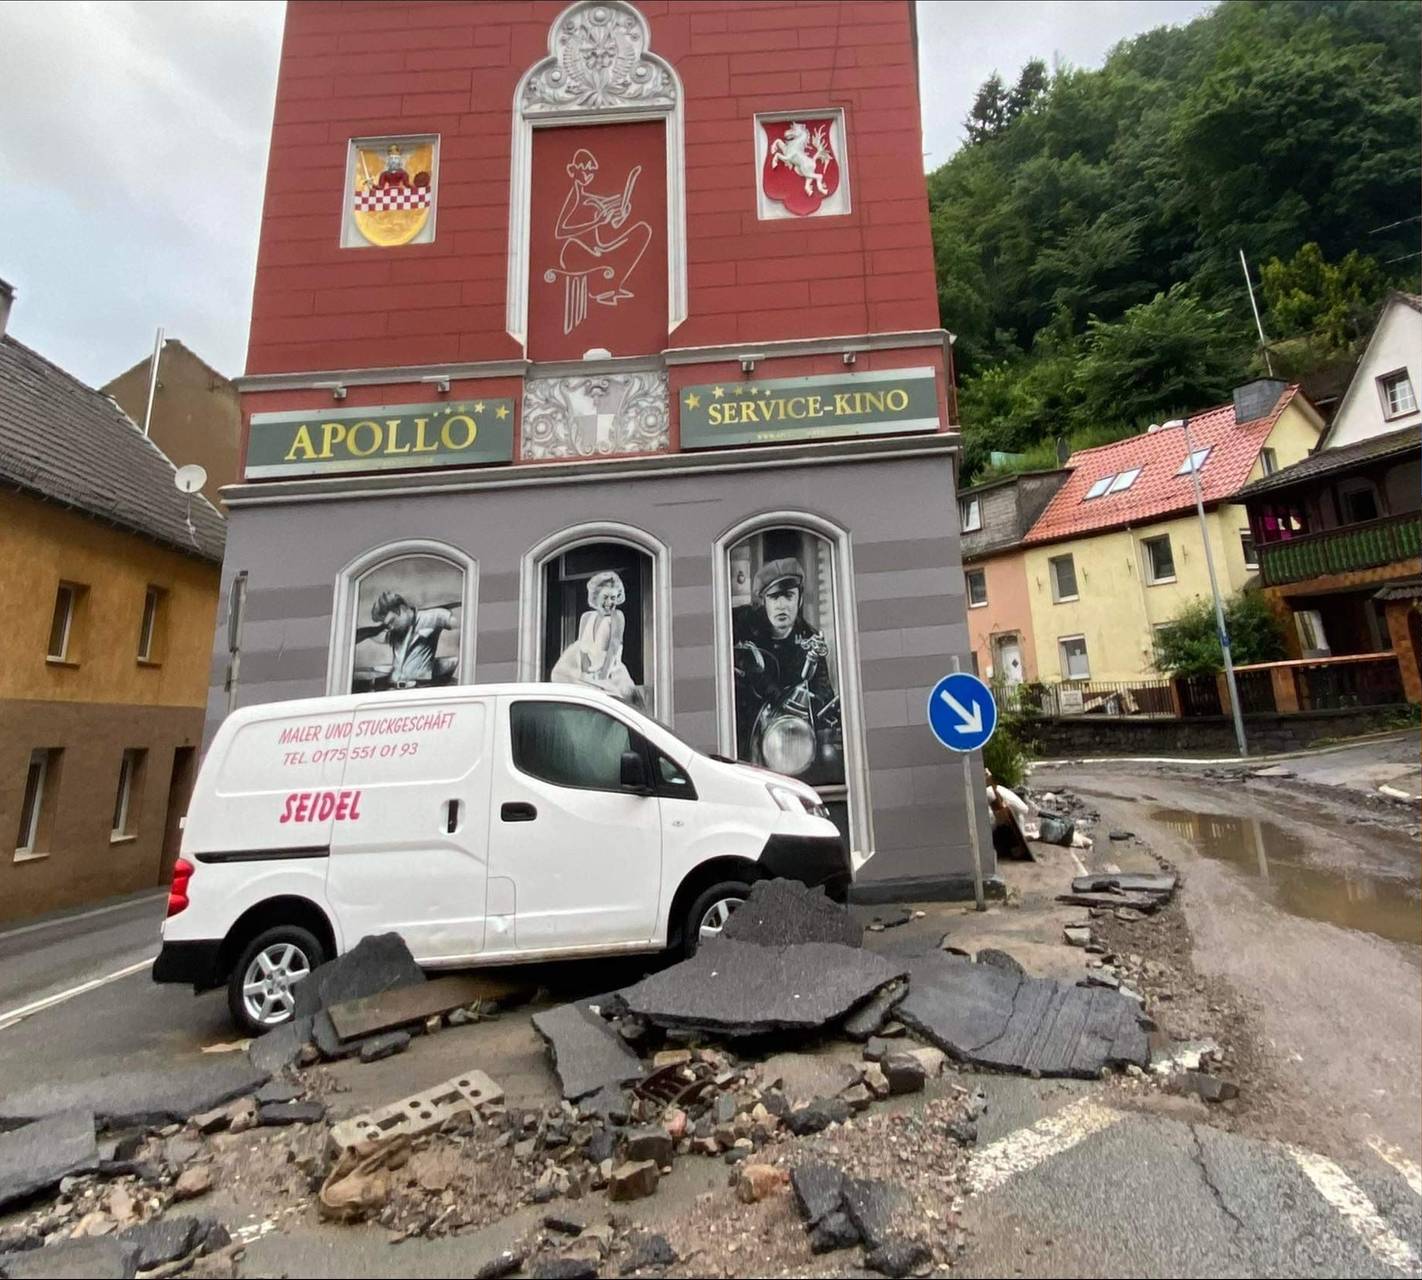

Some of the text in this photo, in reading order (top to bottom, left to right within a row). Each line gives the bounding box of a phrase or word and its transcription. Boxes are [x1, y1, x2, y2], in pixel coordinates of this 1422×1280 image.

[708, 389, 909, 426] SERVICE-KINO
[284, 415, 478, 461] APOLLO
[278, 710, 456, 744] MALER UND STUCKGESCHÄFT
[312, 748, 346, 763] 0175
[350, 745, 377, 760] 551
[380, 744, 396, 757] 01
[399, 742, 419, 757] 93
[279, 790, 362, 824] SEIDEL
